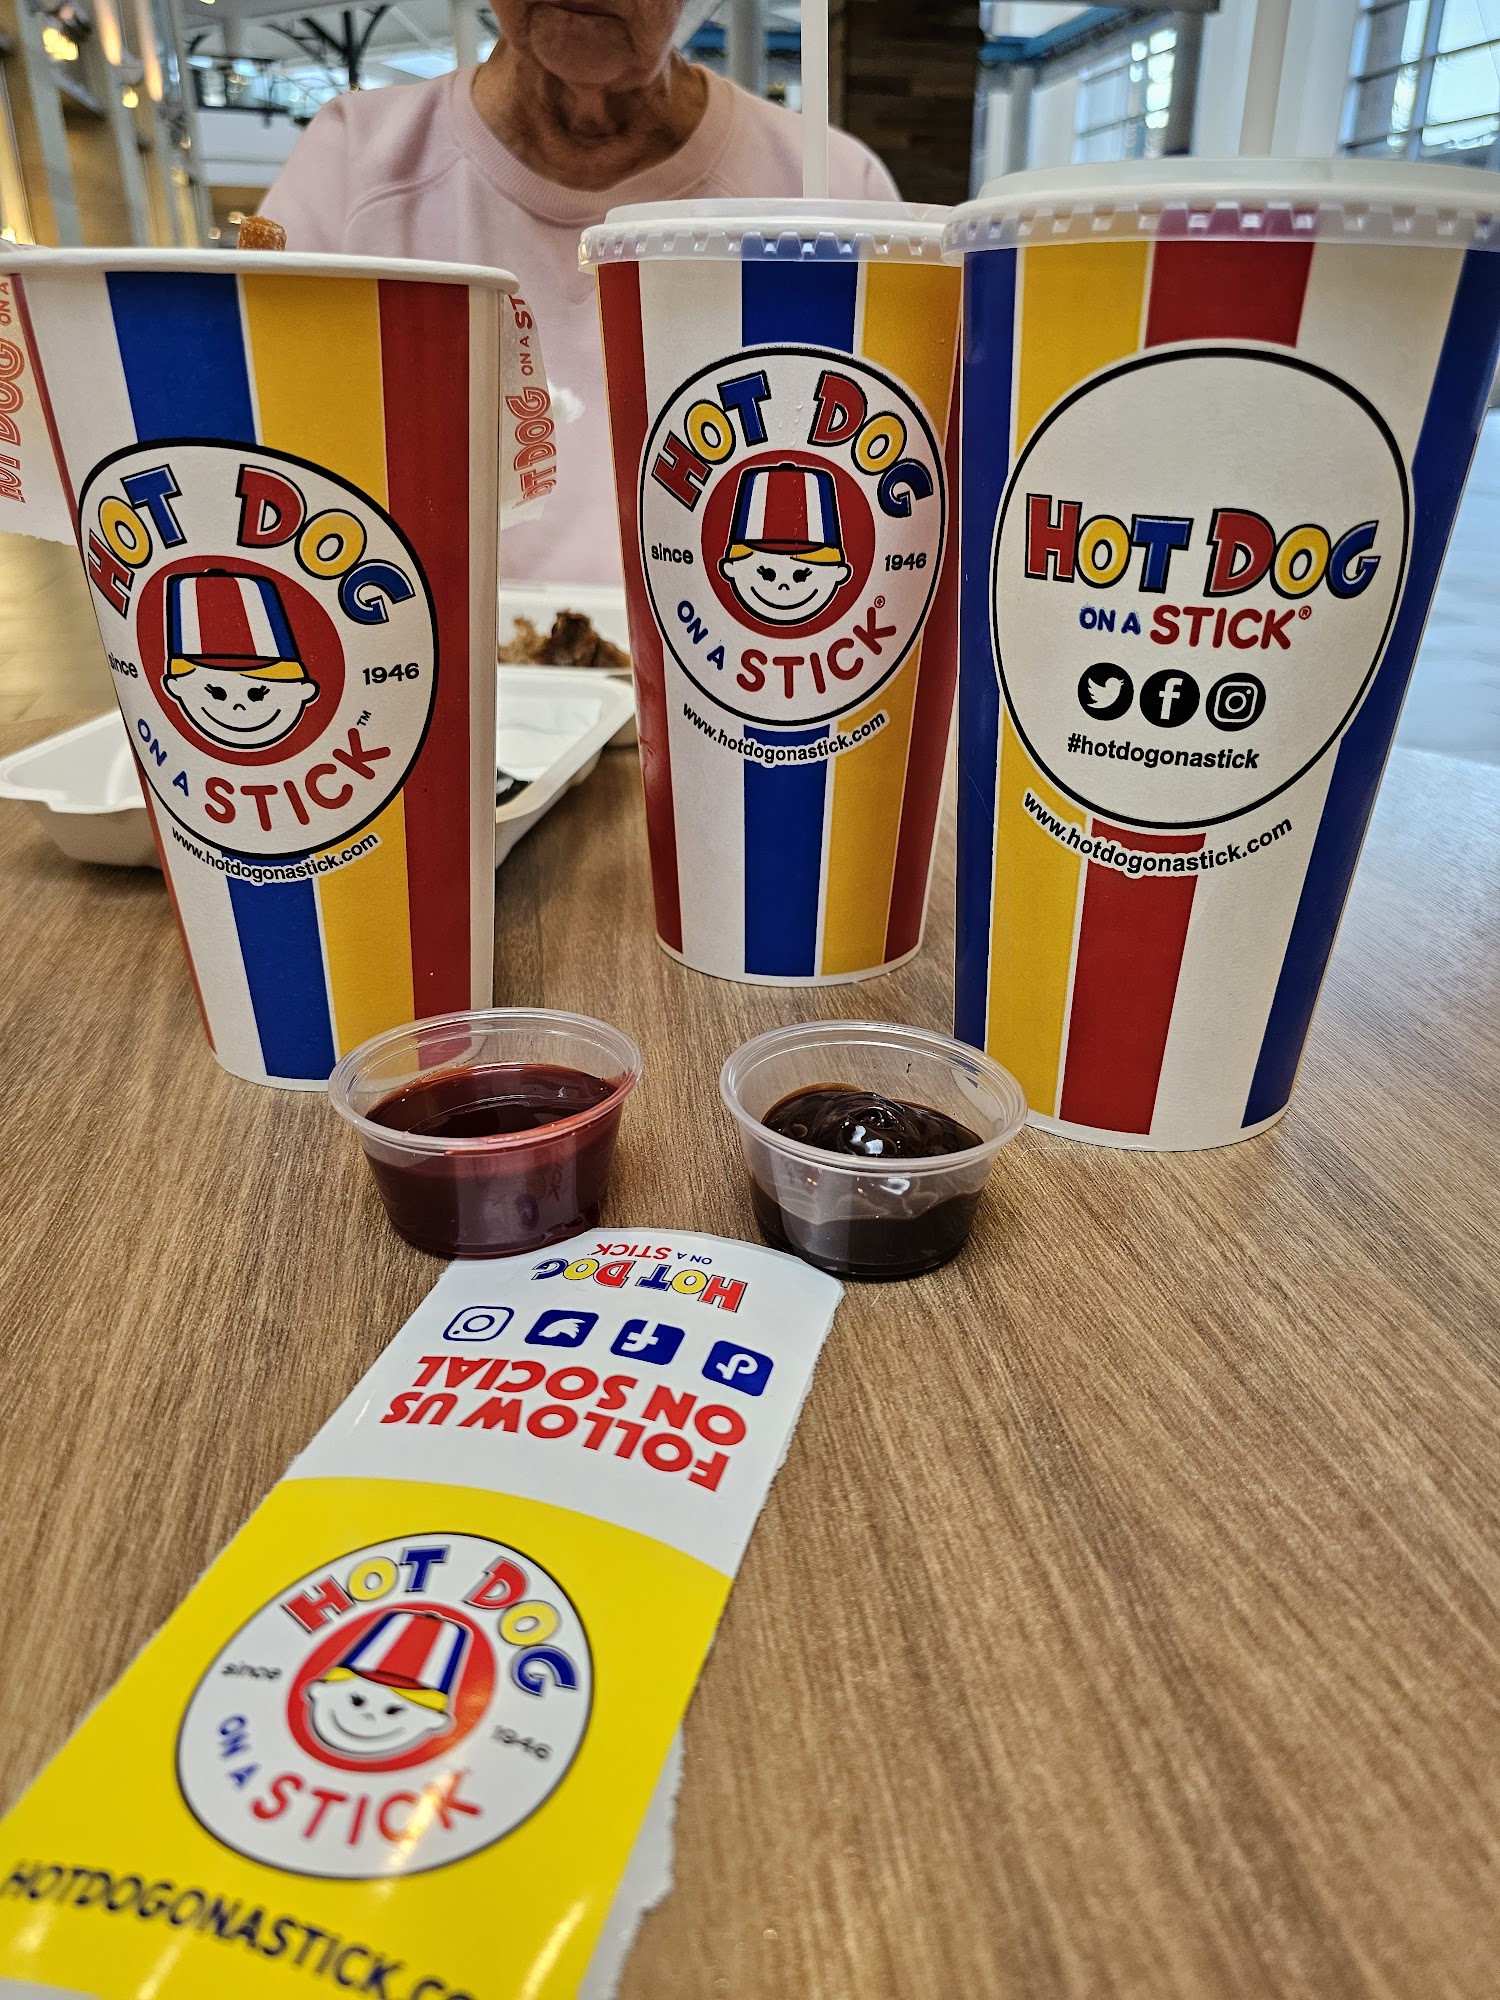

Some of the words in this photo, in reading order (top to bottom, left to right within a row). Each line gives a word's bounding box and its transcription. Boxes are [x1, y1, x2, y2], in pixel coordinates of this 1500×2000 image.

[519, 335, 530, 348] A
[520, 353, 534, 376] ON
[506, 387, 557, 472] DOG
[651, 369, 771, 512] HOT
[807, 369, 934, 518] DOG
[88, 463, 188, 620] HOT
[235, 463, 416, 625] DOG
[651, 543, 694, 565] since
[884, 553, 928, 572] 1946
[1024, 493, 1194, 594] HOT
[1203, 507, 1381, 599] DOG
[677, 600, 709, 645] ON
[706, 645, 726, 670] A
[1079, 606, 1116, 633] ON
[1120, 611, 1141, 635] A
[108, 652, 138, 679] since
[362, 661, 420, 686] 1946
[137, 718, 168, 767] ON
[172, 770, 190, 797] A
[683, 703, 886, 763] www.hotdogonastick.com
[1067, 732, 1260, 770] #hotdogonastick
[171, 826, 379, 883] www.hotdogonastick.com
[1024, 792, 1293, 874] www.hotdogonastick.com
[531, 1258, 637, 1288] DOG
[676, 1252, 689, 1260] A
[690, 1256, 713, 1265] ON
[635, 1264, 748, 1313] HOT
[412, 1356, 639, 1411] SOCIAL
[380, 1392, 460, 1427] US
[642, 1384, 747, 1446] ON
[460, 1396, 730, 1493] FOLLOW
[282, 1544, 452, 1634] HOT
[462, 1556, 577, 1697] DOG
[220, 1659, 283, 1683] since
[491, 1723, 553, 1761] 1946
[250, 1772, 483, 1847] STICK
